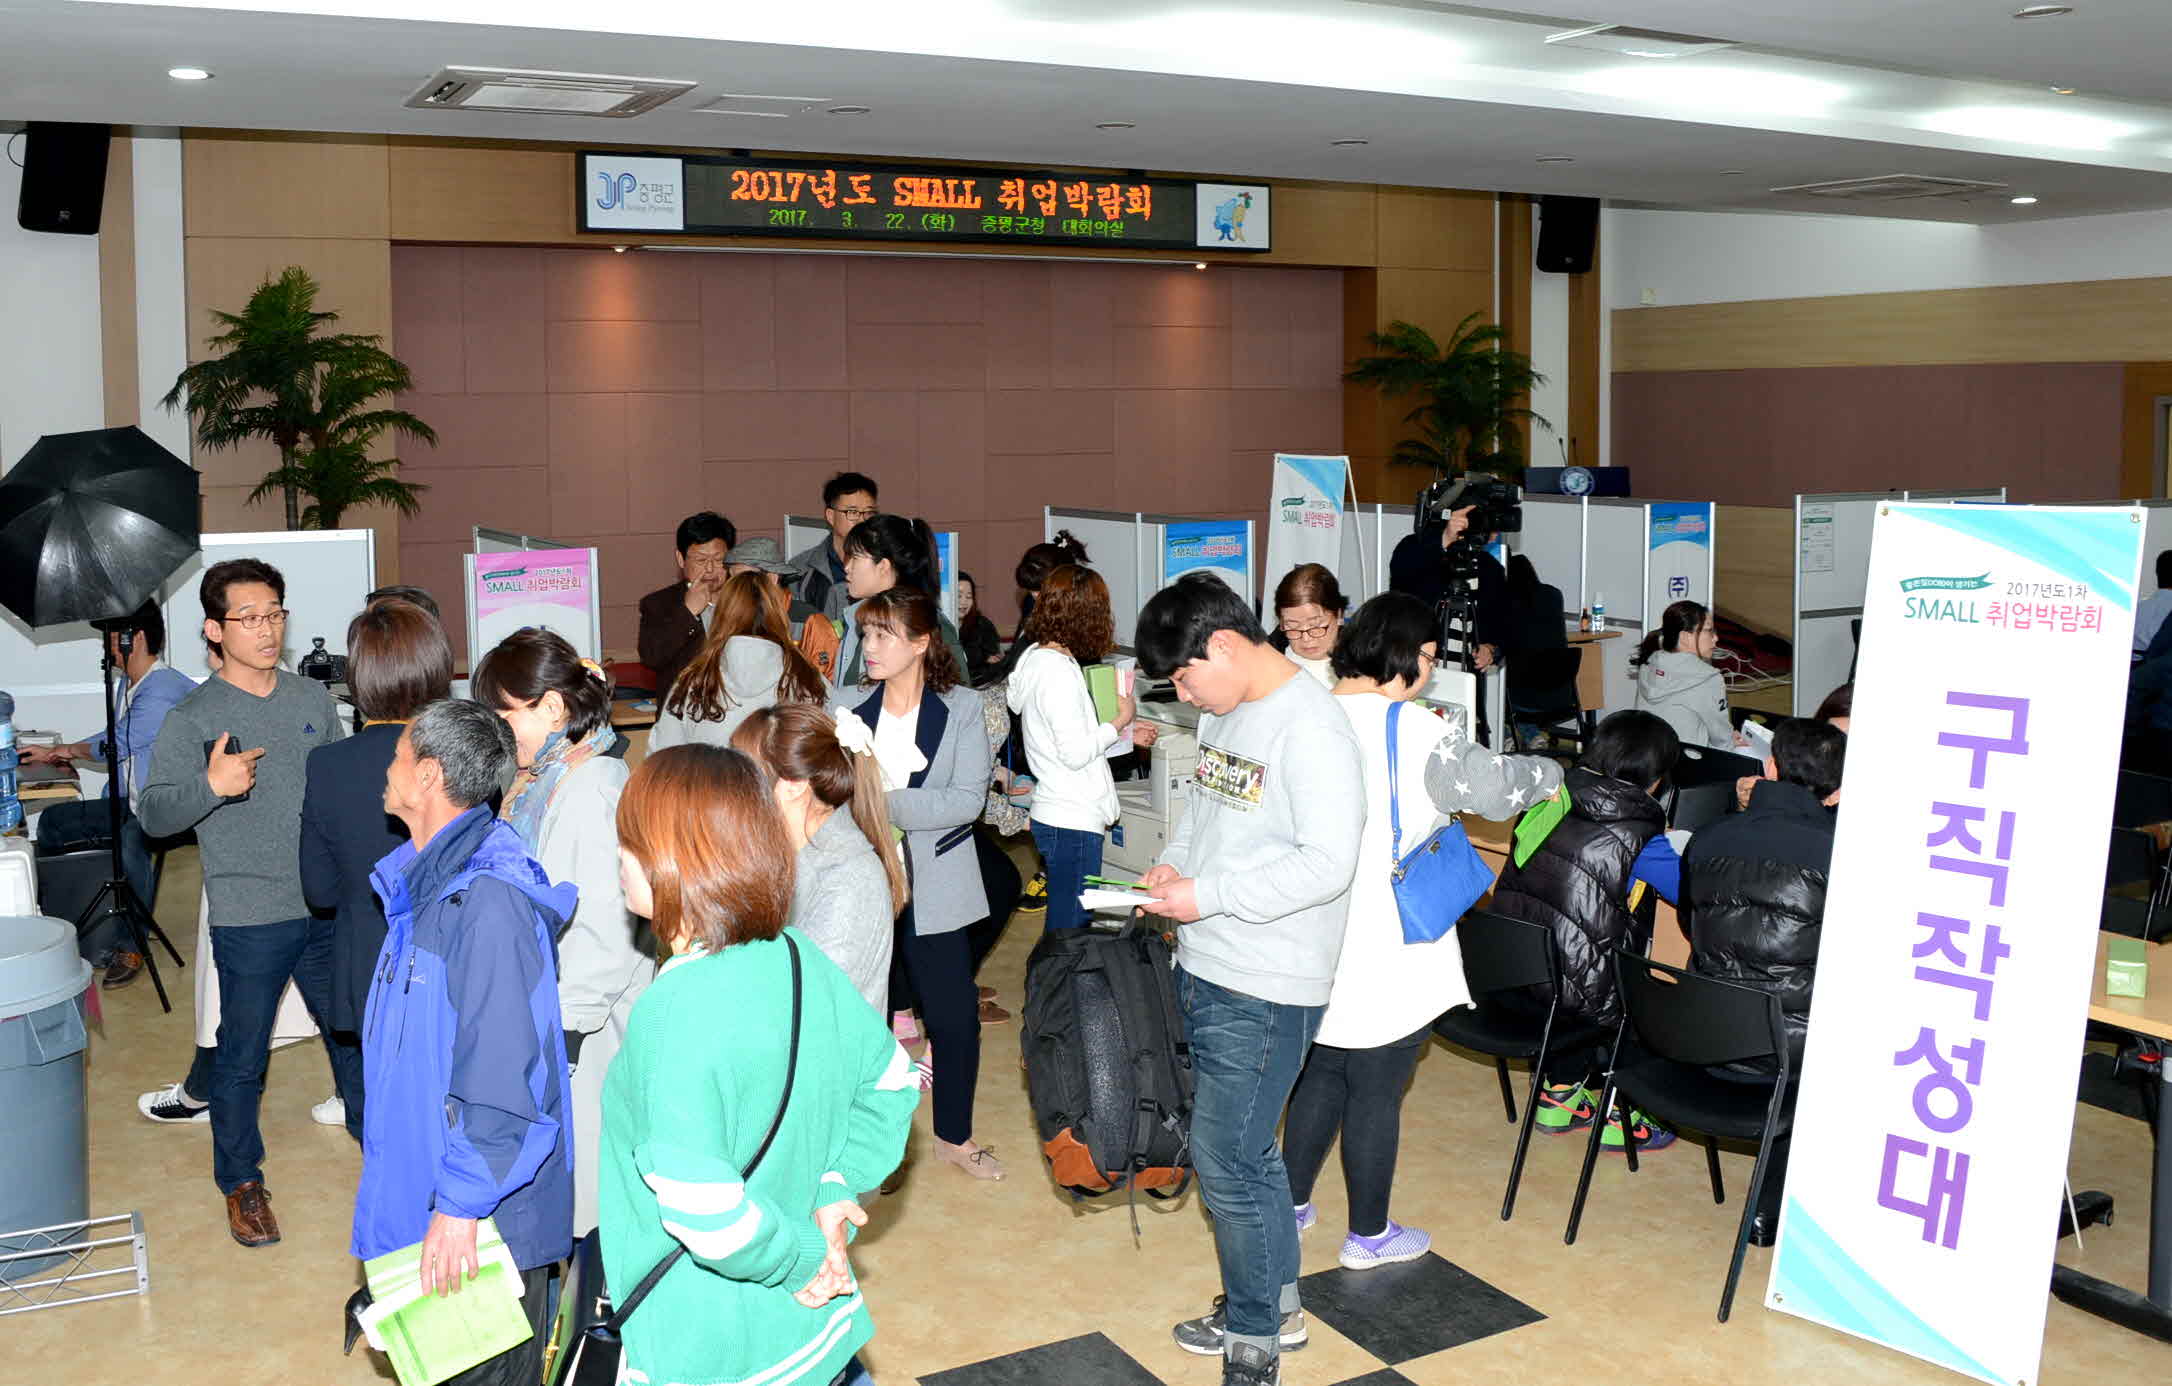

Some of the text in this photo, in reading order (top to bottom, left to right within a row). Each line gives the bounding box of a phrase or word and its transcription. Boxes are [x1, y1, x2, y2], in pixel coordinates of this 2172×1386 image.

[731, 169, 1152, 221] 2017년도 SMALL 취업박람회
[920, 213, 956, 232] (화)
[980, 215, 1046, 235] 증평군청
[1061, 218, 1126, 238] 대회의실
[486, 575, 582, 593] SMALL 취업박람회
[2007, 582, 2088, 600] 2017년도1차
[1905, 596, 2103, 634] SMALL 취업박람회
[1876, 690, 2032, 1251] 구직작성대
